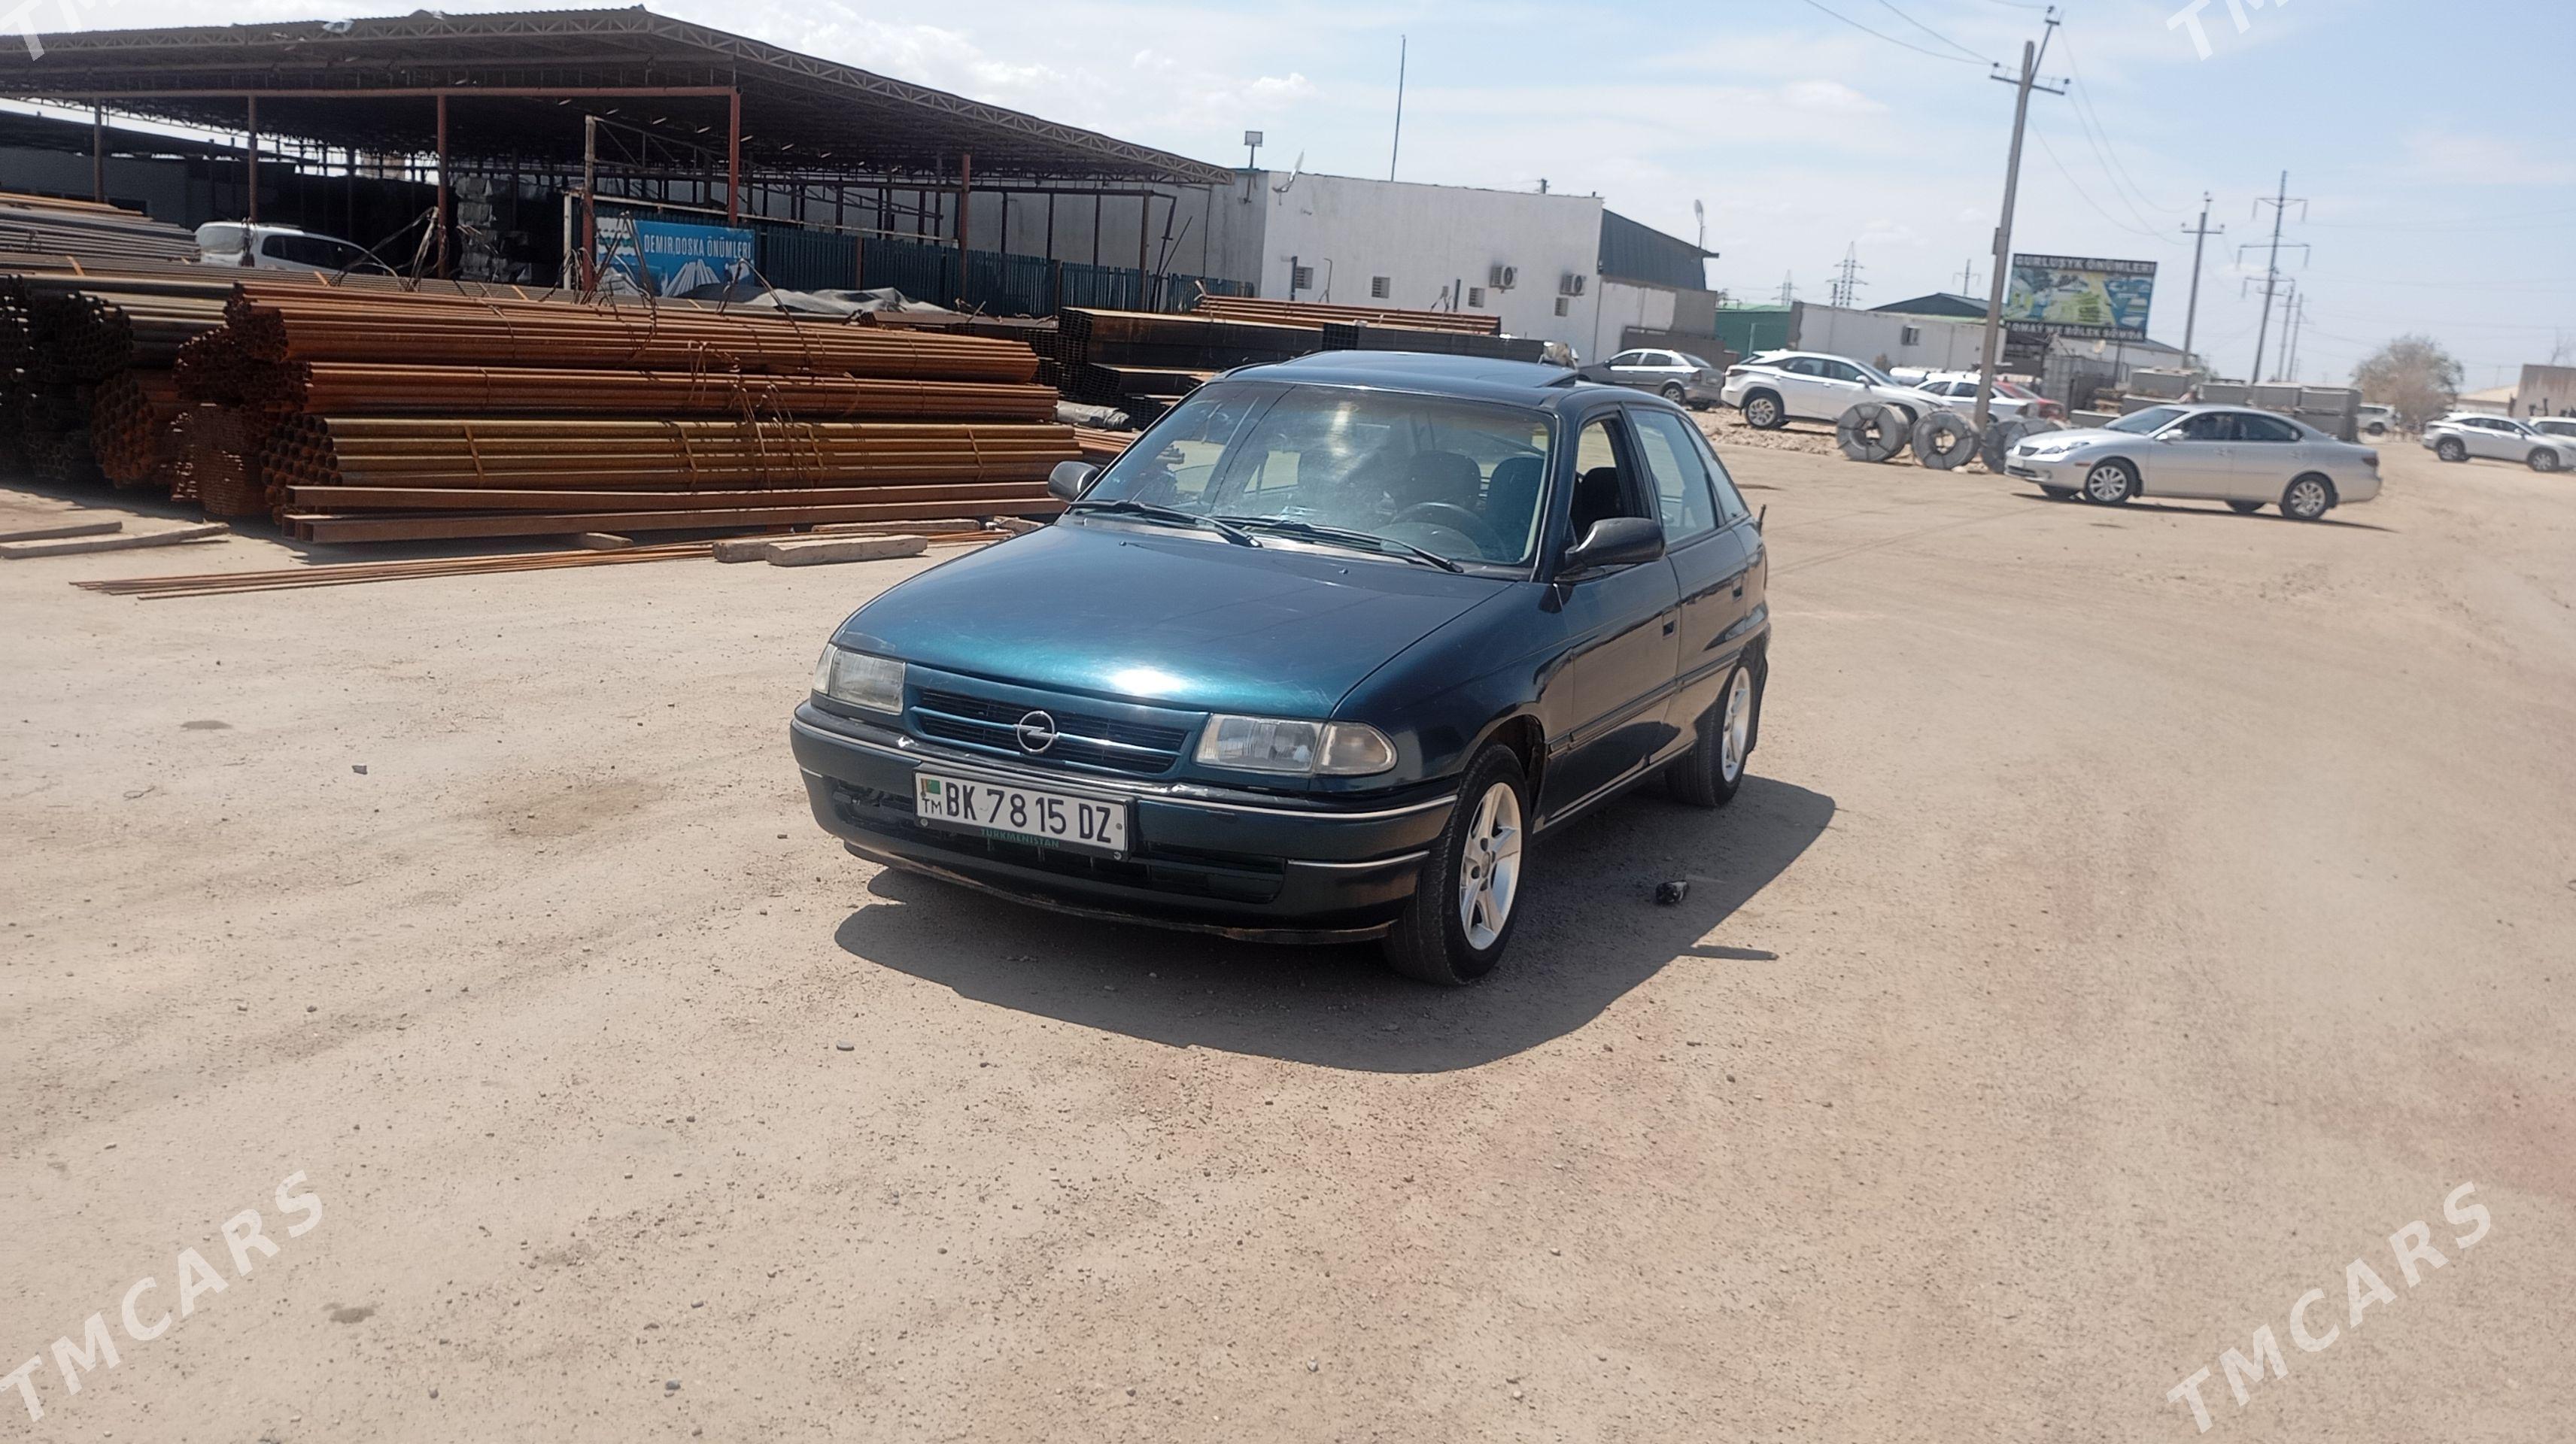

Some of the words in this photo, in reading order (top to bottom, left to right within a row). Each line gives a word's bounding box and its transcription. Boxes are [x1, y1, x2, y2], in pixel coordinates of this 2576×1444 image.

[922, 797, 942, 815] TM
[945, 781, 977, 821] BK
[1078, 802, 1112, 843] DZ
